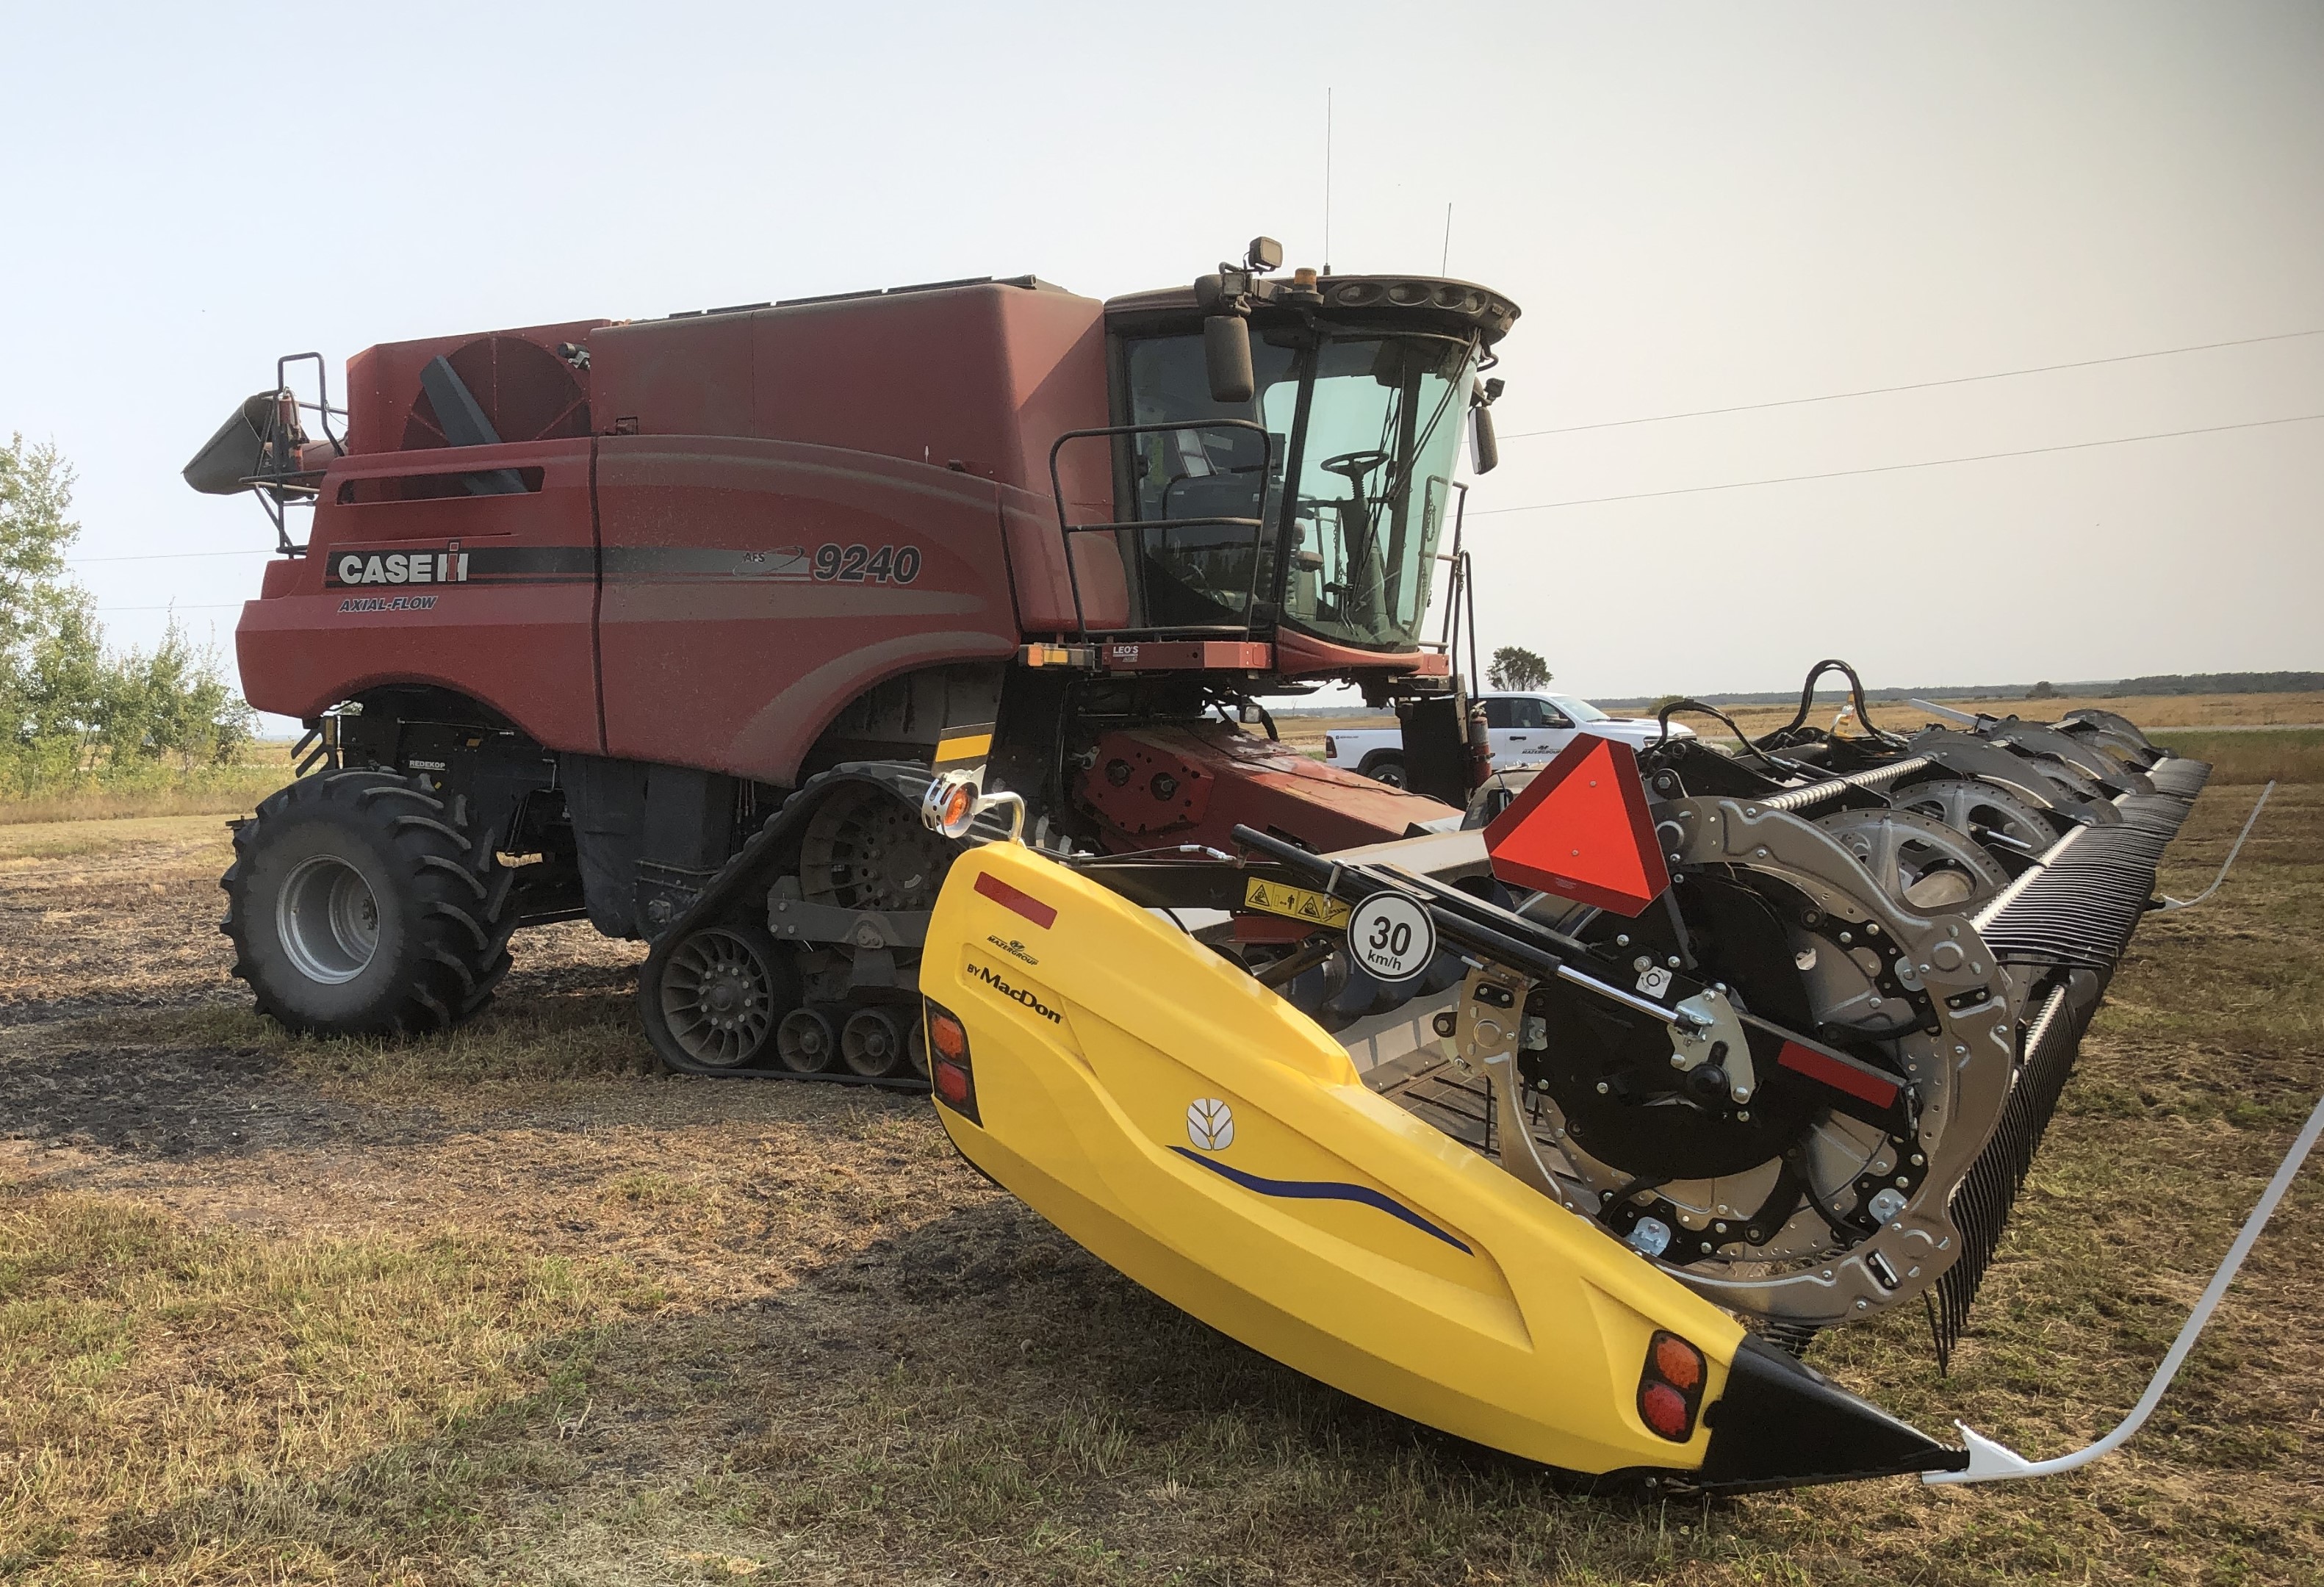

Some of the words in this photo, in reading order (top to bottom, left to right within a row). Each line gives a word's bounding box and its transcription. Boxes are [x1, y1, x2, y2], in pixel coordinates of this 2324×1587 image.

[339, 554, 432, 584] CASE
[744, 552, 766, 563] AFS
[813, 543, 922, 585] 9240
[337, 595, 439, 613] AXIAL-FLOW
[1112, 645, 1139, 654] LEO'S
[409, 760, 446, 769] REDEKOP
[1369, 915, 1412, 957] 30
[987, 935, 1038, 965] MAZERGROUP
[1367, 949, 1402, 971] km/h
[967, 963, 981, 976] BY
[979, 966, 1062, 1024] MacDon
